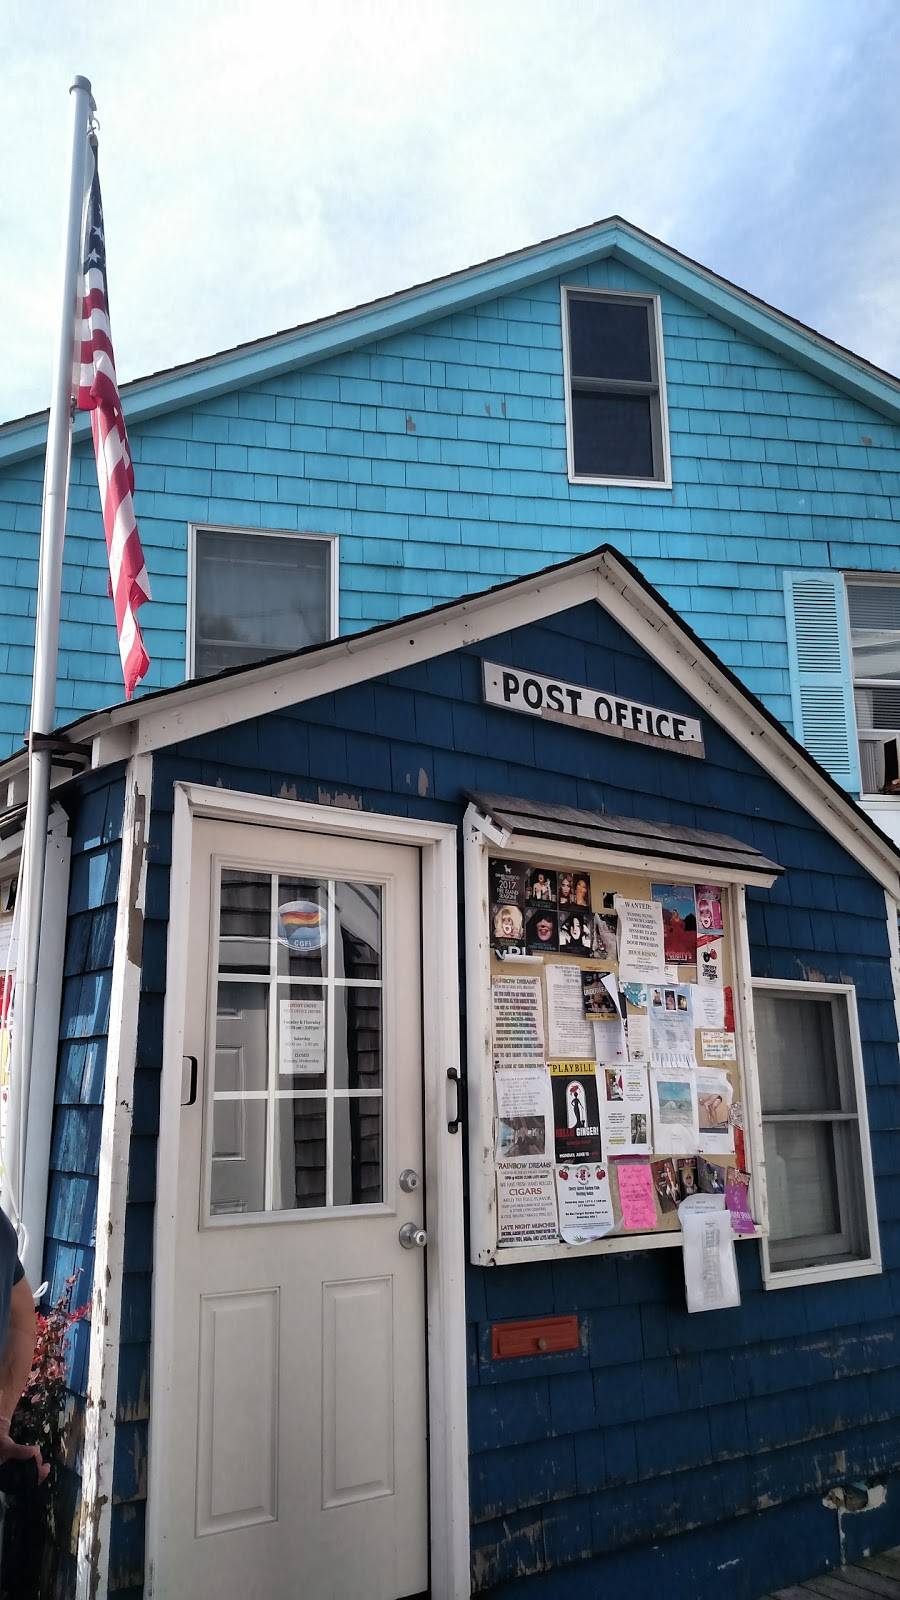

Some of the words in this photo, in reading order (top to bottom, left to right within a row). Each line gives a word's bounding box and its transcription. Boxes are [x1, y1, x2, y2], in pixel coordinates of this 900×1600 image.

[502, 671, 582, 715] POST
[594, 697, 687, 741] OFFICE
[498, 879, 517, 890] 2017
[624, 901, 652, 911] WANTED:
[584, 985, 607, 996] UNDERWE
[552, 1064, 593, 1073] PLAYBILL
[576, 1127, 600, 1137] GINGER!
[508, 1187, 542, 1196] CIGARS
